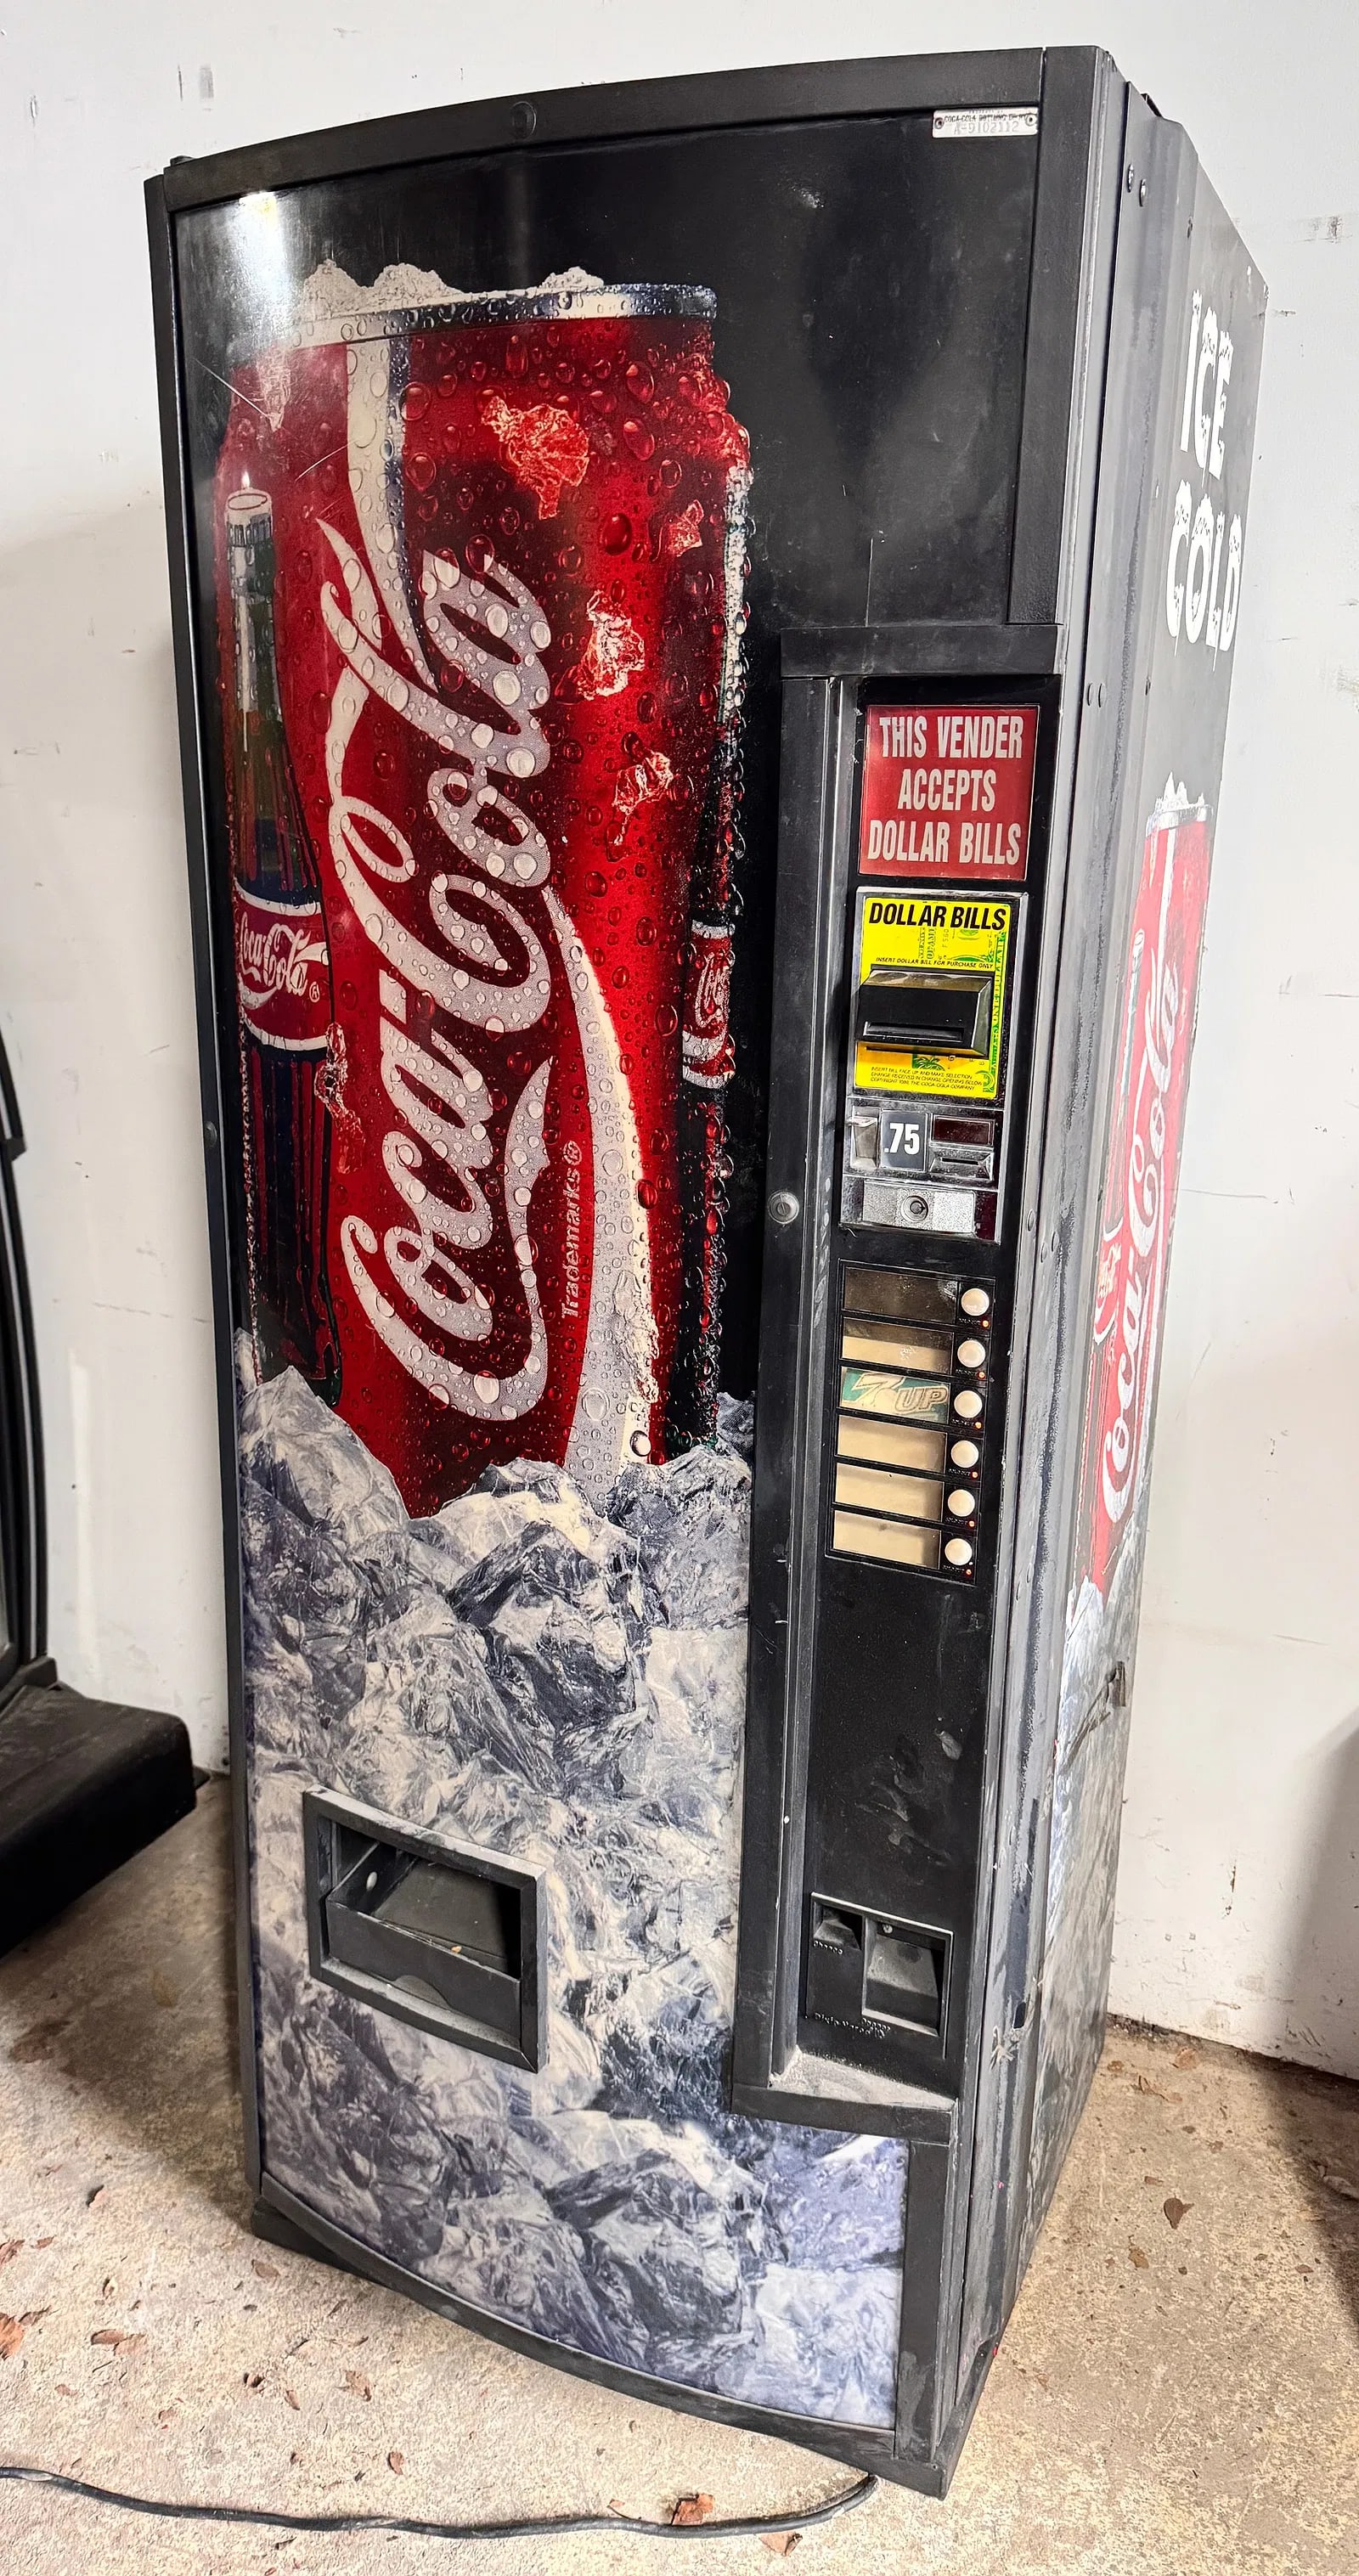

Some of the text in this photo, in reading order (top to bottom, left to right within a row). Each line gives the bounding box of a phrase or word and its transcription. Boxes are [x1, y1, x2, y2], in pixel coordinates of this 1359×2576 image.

[1181, 289, 1234, 488] ICE
[1166, 479, 1243, 671] COLD
[879, 716, 1023, 758] THIS VENDER
[897, 768, 996, 812] ACCEPTS
[867, 820, 1022, 865] DOLLAR BILLS
[869, 902, 1007, 931] DOLLAR BILLS
[315, 516, 551, 1421] Coca-Cola
[883, 1122, 920, 1155] .75
[1102, 945, 1179, 1521] Coca-Cola
